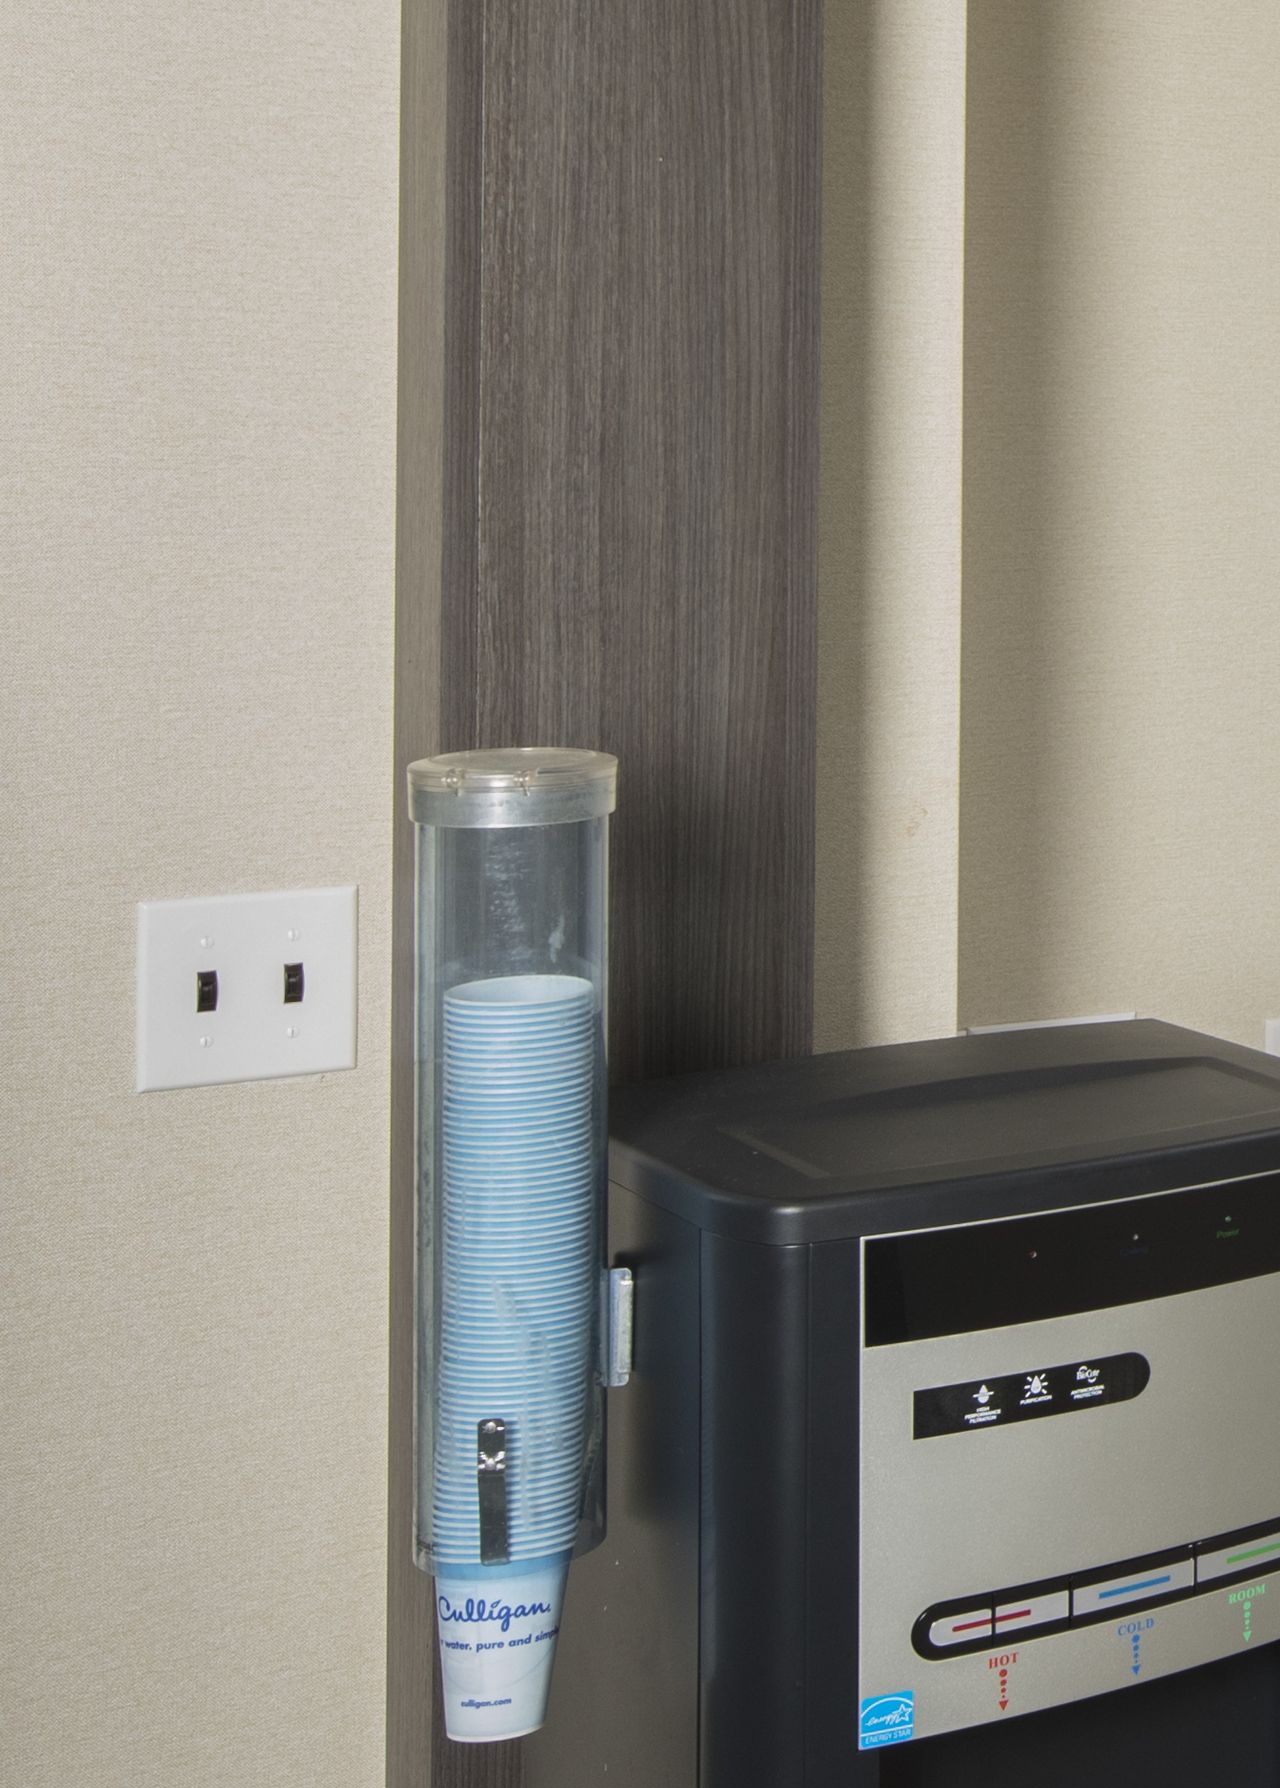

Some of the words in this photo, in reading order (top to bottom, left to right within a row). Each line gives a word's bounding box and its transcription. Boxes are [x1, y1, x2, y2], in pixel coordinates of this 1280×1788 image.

[1227, 1583, 1267, 1605] ROOM
[438, 1595, 550, 1632] Culligan
[1118, 1617, 1154, 1636] COLD
[476, 1641, 505, 1653] pure
[509, 1634, 532, 1647] and
[988, 1652, 1019, 1669] HOT
[865, 1733, 892, 1744] ENERGY
[893, 1729, 911, 1739] STAR
